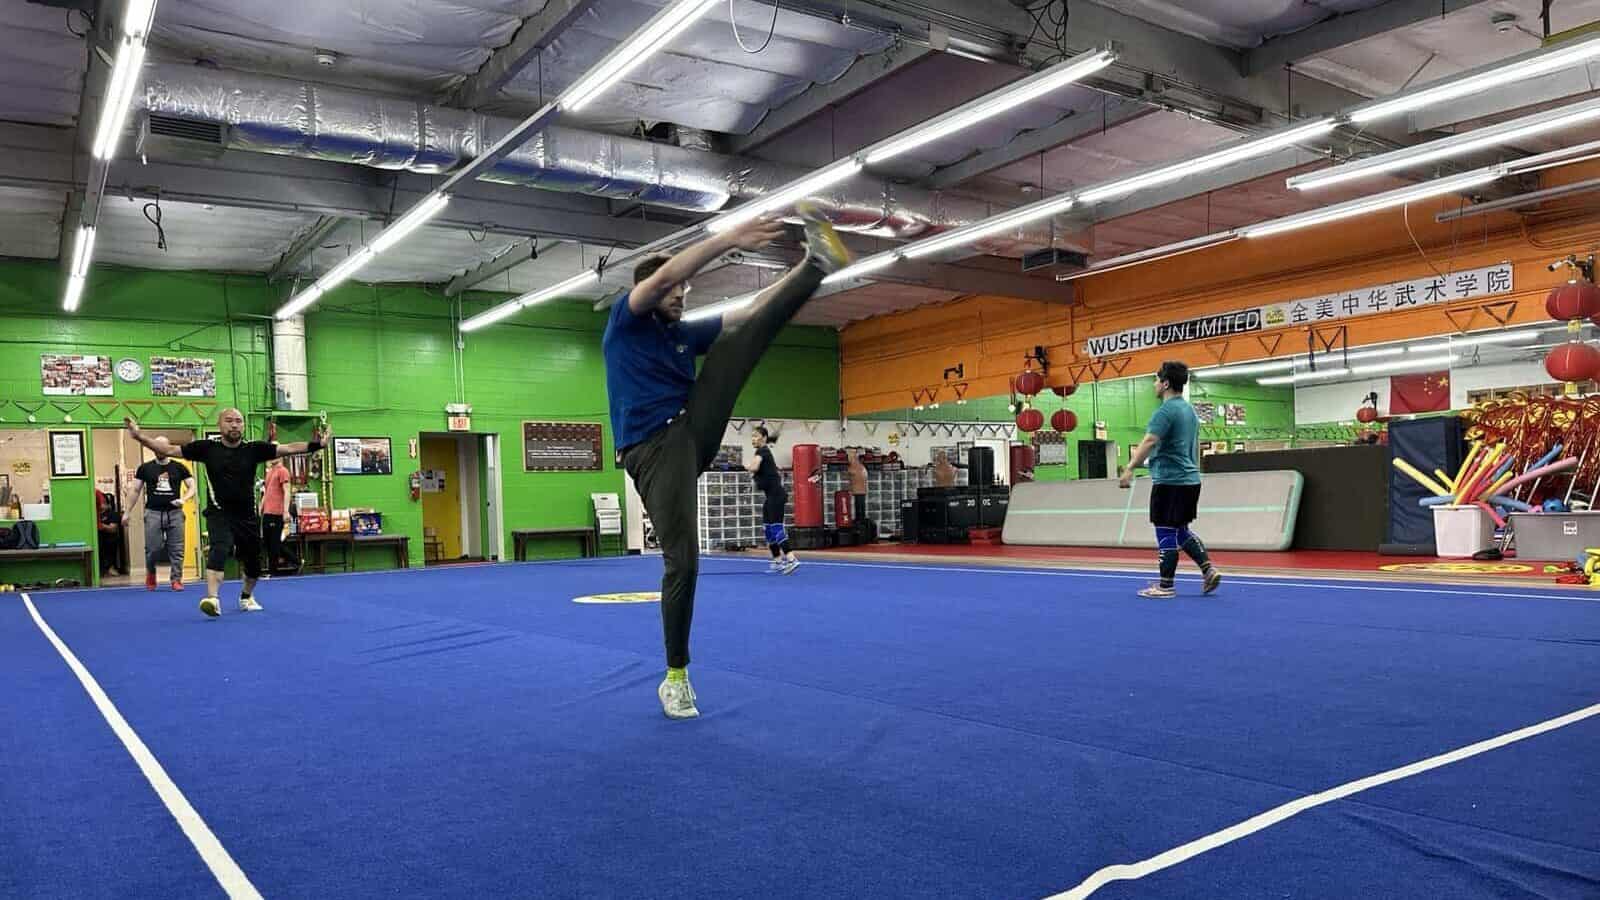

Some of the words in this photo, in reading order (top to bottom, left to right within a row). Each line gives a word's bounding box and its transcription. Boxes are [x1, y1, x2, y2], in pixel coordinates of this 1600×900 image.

[1291, 268, 1511, 324] 全美中华武术学院
